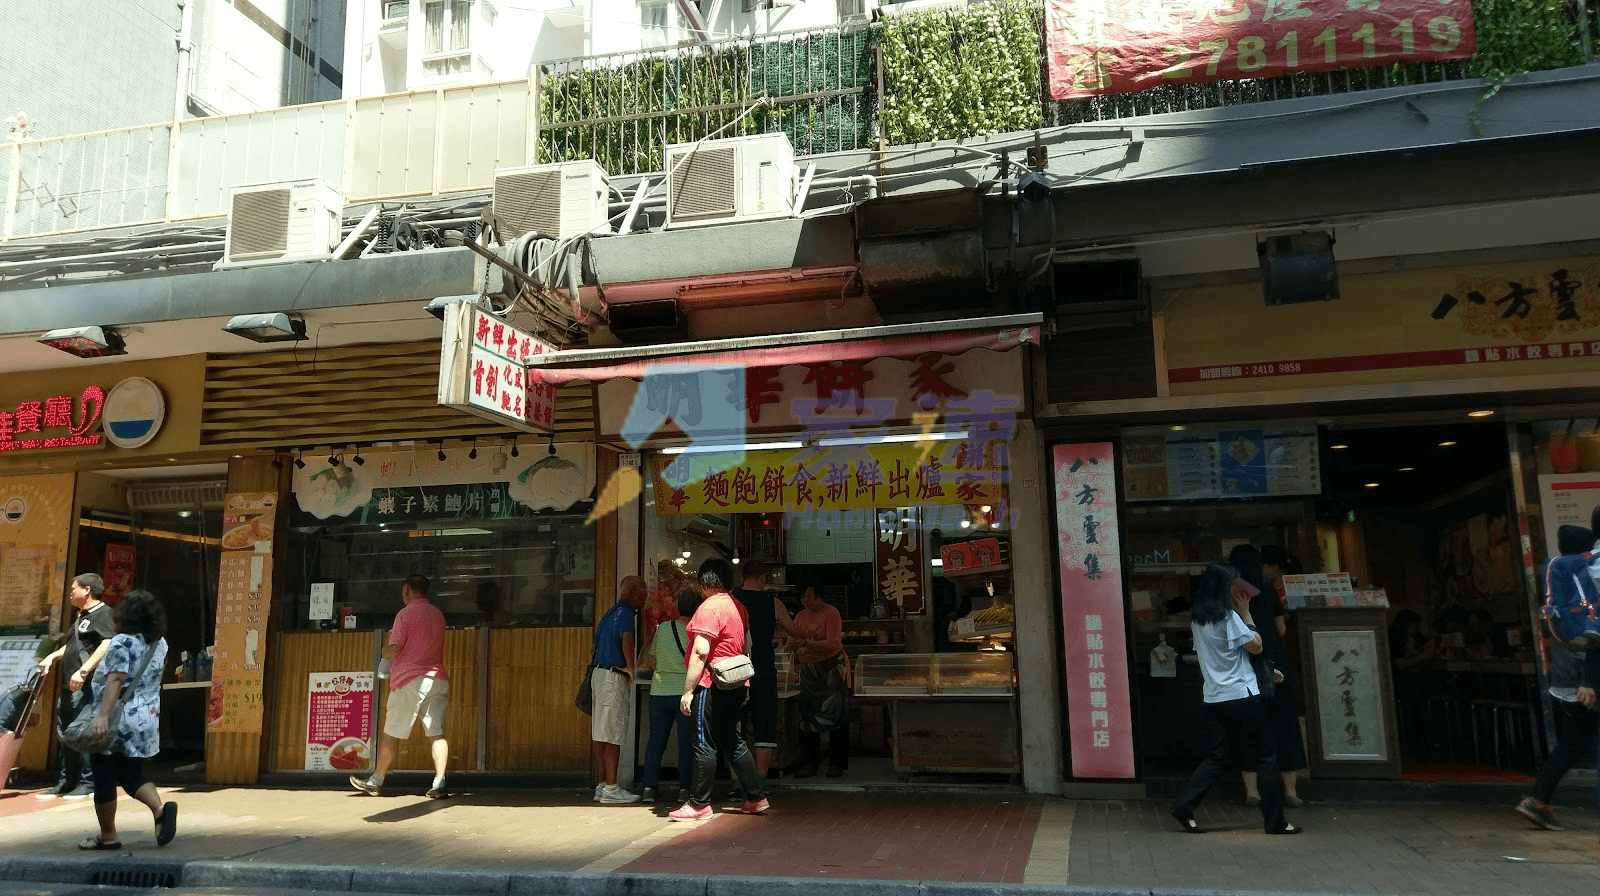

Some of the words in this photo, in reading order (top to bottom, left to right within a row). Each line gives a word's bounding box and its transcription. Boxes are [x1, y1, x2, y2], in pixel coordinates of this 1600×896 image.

[565, 172, 591, 180] Panasonic
[293, 182, 316, 190] Panasonic
[1252, 364, 1275, 375] 2410
[1278, 362, 1302, 374] 9858
[877, 506, 920, 608] 明華
